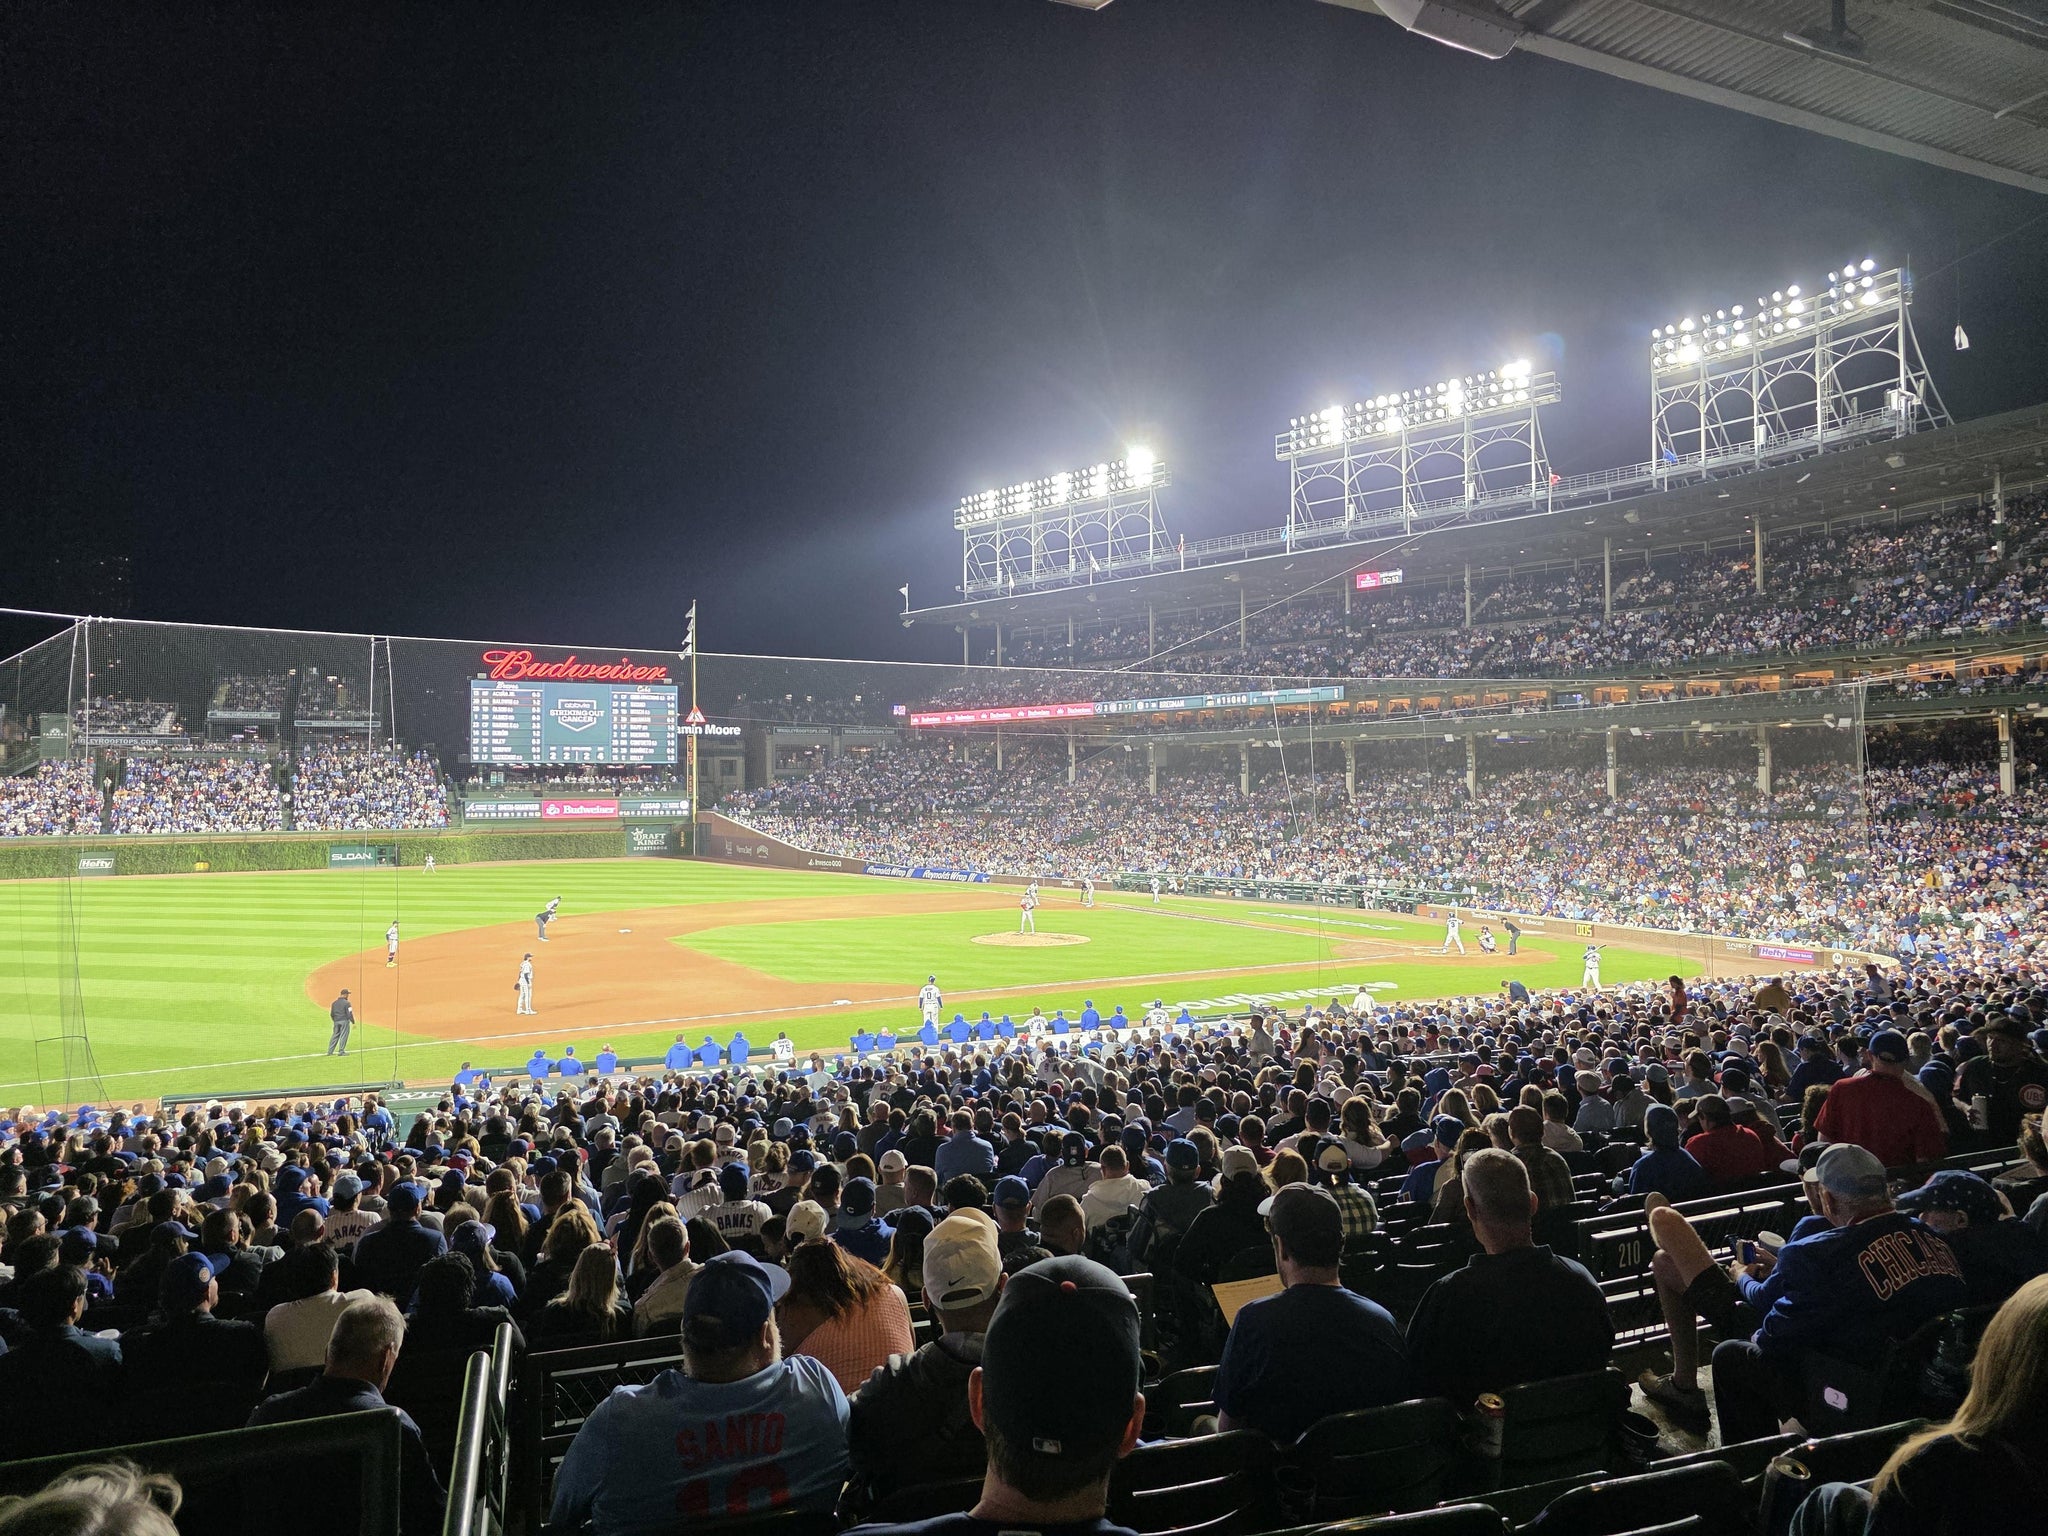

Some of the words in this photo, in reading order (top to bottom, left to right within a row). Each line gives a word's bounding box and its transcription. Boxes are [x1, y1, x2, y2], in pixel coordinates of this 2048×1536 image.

[482, 650, 667, 680] Budweiser
[705, 724, 741, 735] Moore
[549, 752, 557, 760] 2
[563, 752, 571, 760] 2
[583, 752, 591, 761] 2
[597, 752, 604, 761] 4
[563, 804, 615, 814] Budweiser
[633, 832, 666, 842] DRAFT
[81, 859, 112, 868] Hefty
[866, 865, 891, 876] Reynolds
[890, 867, 907, 878] Wrap
[922, 869, 950, 881] Reynolds
[949, 871, 968, 882] Wrap
[1762, 947, 1786, 958] Hefty
[779, 1044, 791, 1054] 75
[716, 1214, 753, 1230] BANKS
[1619, 1240, 1640, 1268] 210
[676, 1411, 786, 1469] SANTO
